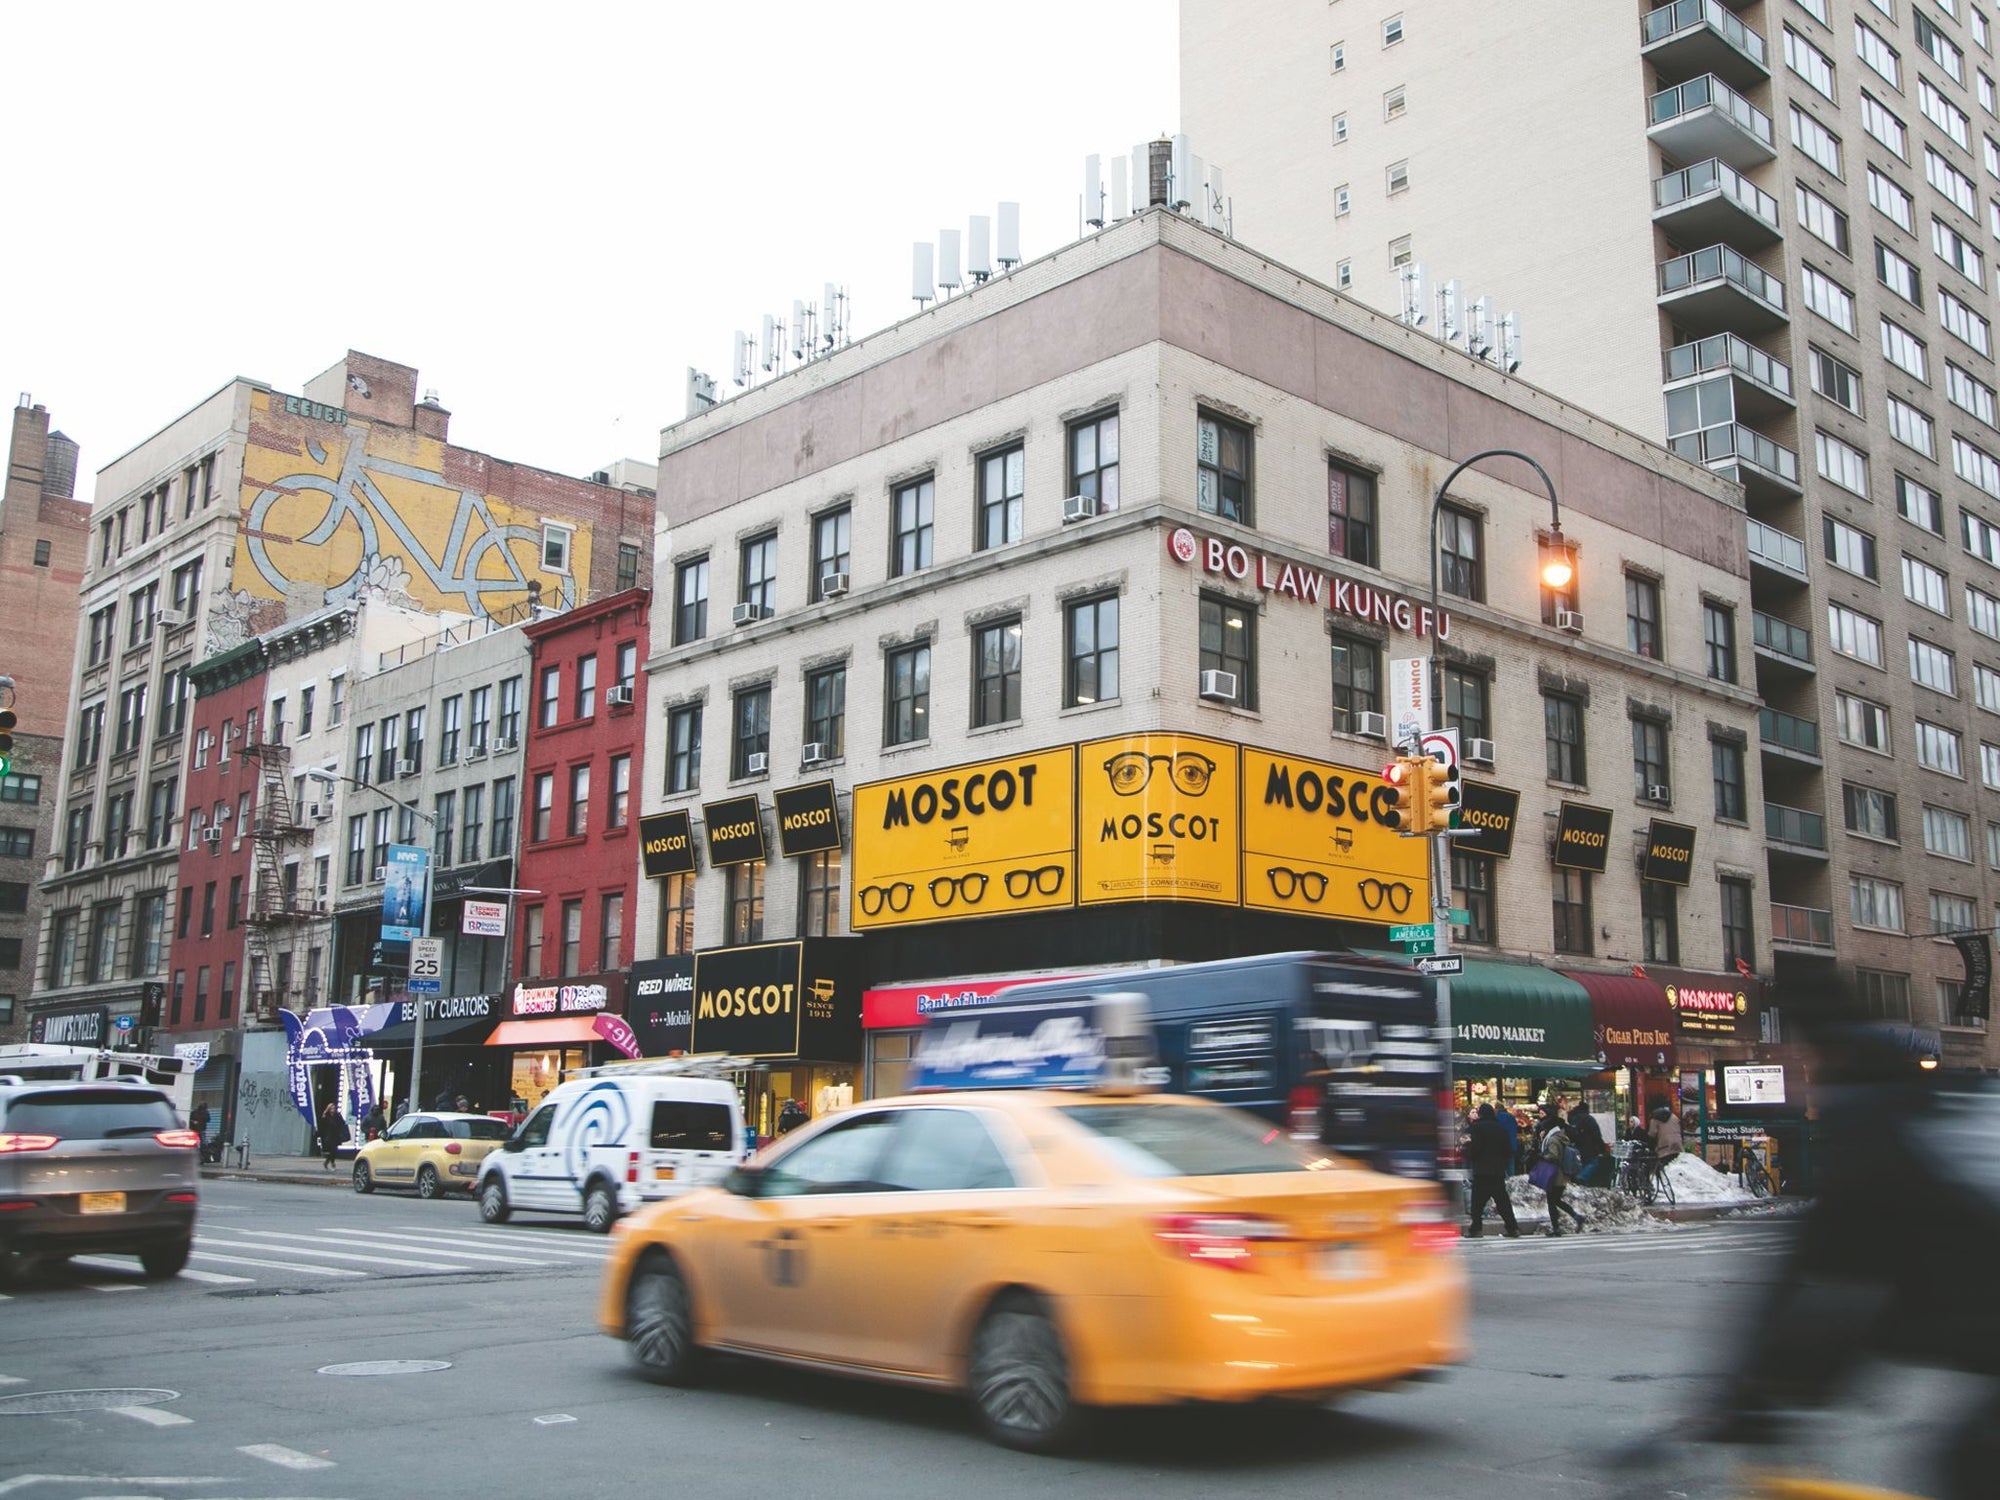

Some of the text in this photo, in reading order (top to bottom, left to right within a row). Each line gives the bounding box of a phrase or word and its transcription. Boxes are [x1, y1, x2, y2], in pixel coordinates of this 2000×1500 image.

[1206, 537, 1249, 579] BO
[1258, 556, 1323, 603] LAW
[1332, 578, 1411, 631] KUNG
[1418, 605, 1450, 640] FU
[882, 764, 1037, 830] MOSCOT
[1264, 763, 1392, 828] MOSCO
[784, 808, 831, 831] MOSCOT
[1100, 812, 1219, 843] MOSCOT
[1462, 808, 1510, 831] MOSCOT
[712, 821, 755, 842] MOSCOT
[1563, 829, 1605, 847] MOSCOT
[646, 835, 687, 854] MOSCOT
[1651, 844, 1690, 862] MOSCOT
[396, 851, 418, 861] NYC
[1395, 928, 1430, 938] AMERICAS
[1413, 942, 1419, 953] 6
[414, 959, 438, 975] 25
[1421, 961, 1456, 971] ONE WAY
[637, 979, 662, 995] REED
[401, 996, 489, 1021] BEATY CURATORS
[525, 1000, 556, 1013] DONUTS
[698, 983, 794, 1019] MOSCOT
[806, 1001, 834, 1010] SINCE
[917, 994, 950, 1013] Bank
[1679, 987, 1735, 1012] NANKING
[809, 1010, 832, 1019] 1915
[45, 1012, 100, 1043] DANNY'S CYCLES
[1457, 1024, 1545, 1043] 14 FOOD MARKET
[1717, 1126, 1738, 1134] Street
[1740, 1126, 1764, 1134] Station
